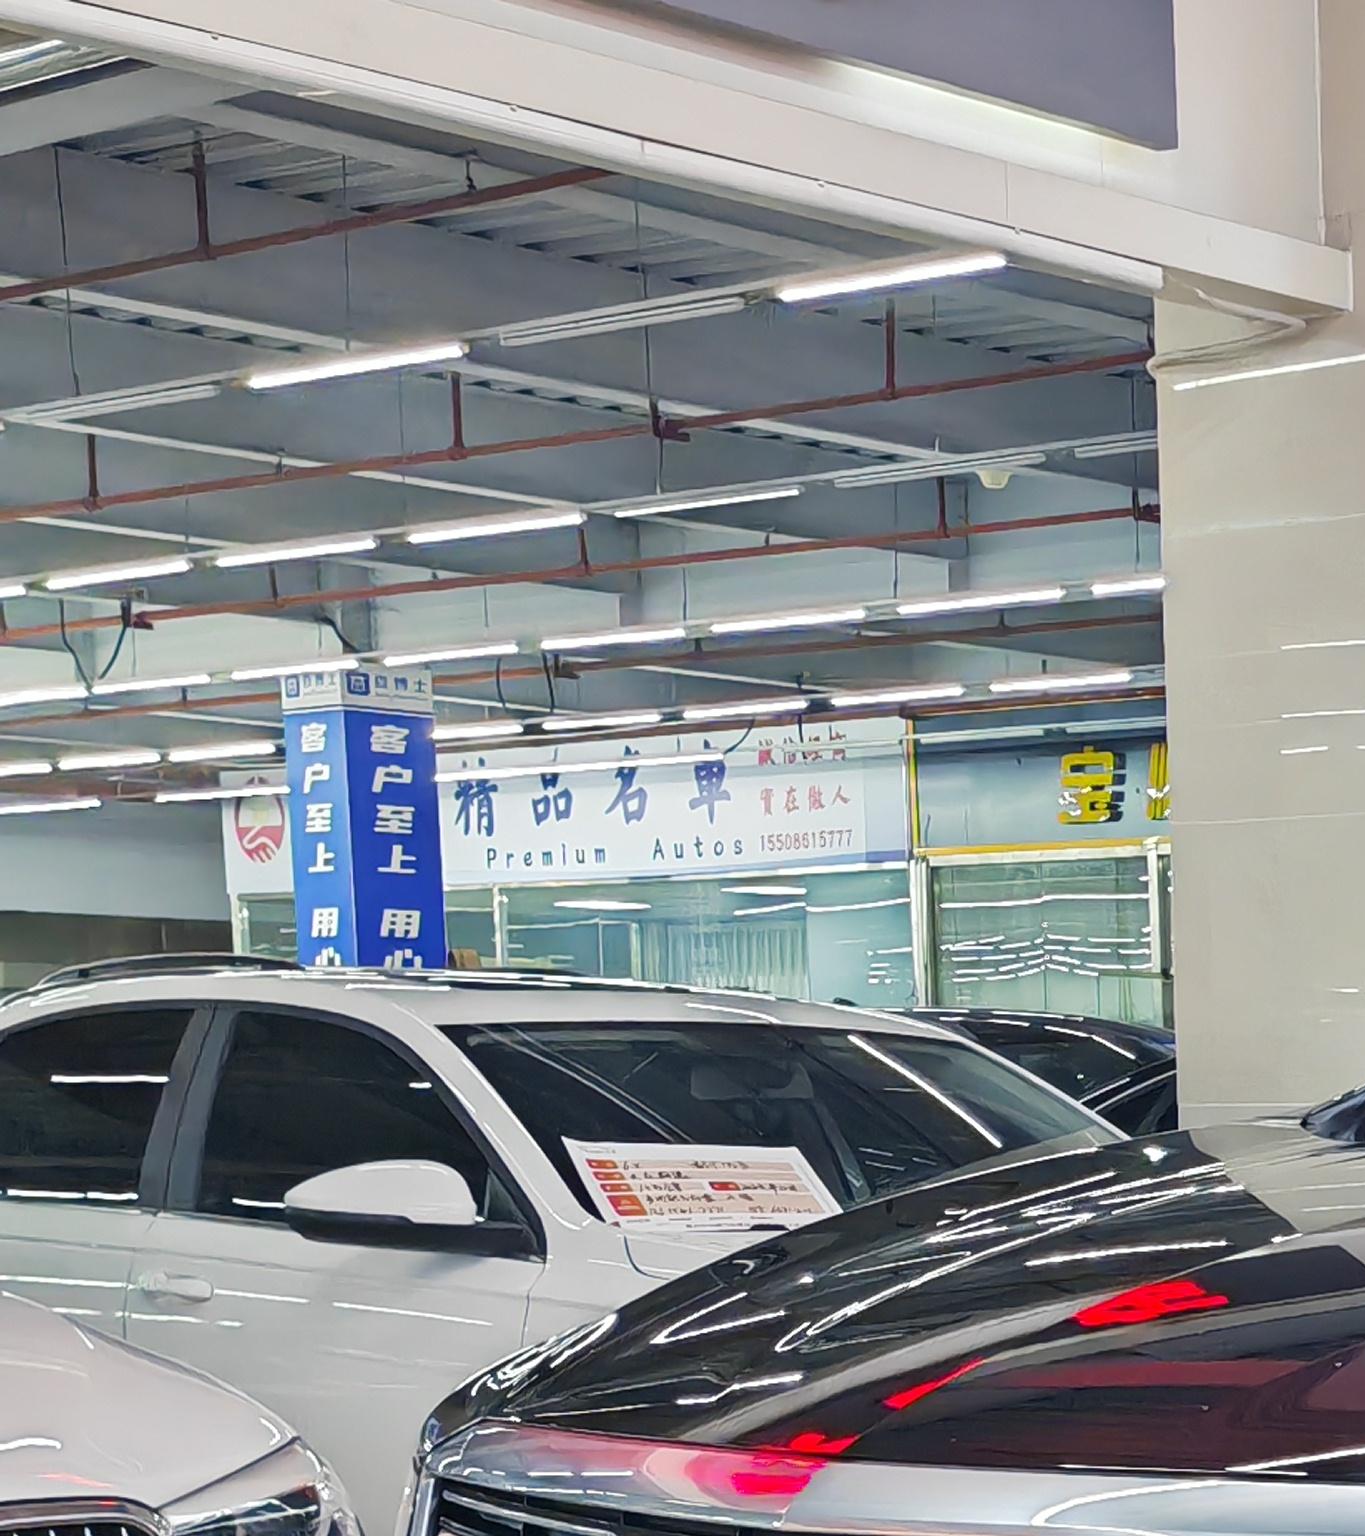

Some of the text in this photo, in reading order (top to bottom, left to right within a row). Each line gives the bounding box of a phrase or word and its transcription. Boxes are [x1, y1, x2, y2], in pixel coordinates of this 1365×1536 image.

[301, 722, 335, 874] 客户至上
[370, 724, 417, 874] 客户至上
[486, 837, 744, 870] Premium Autos
